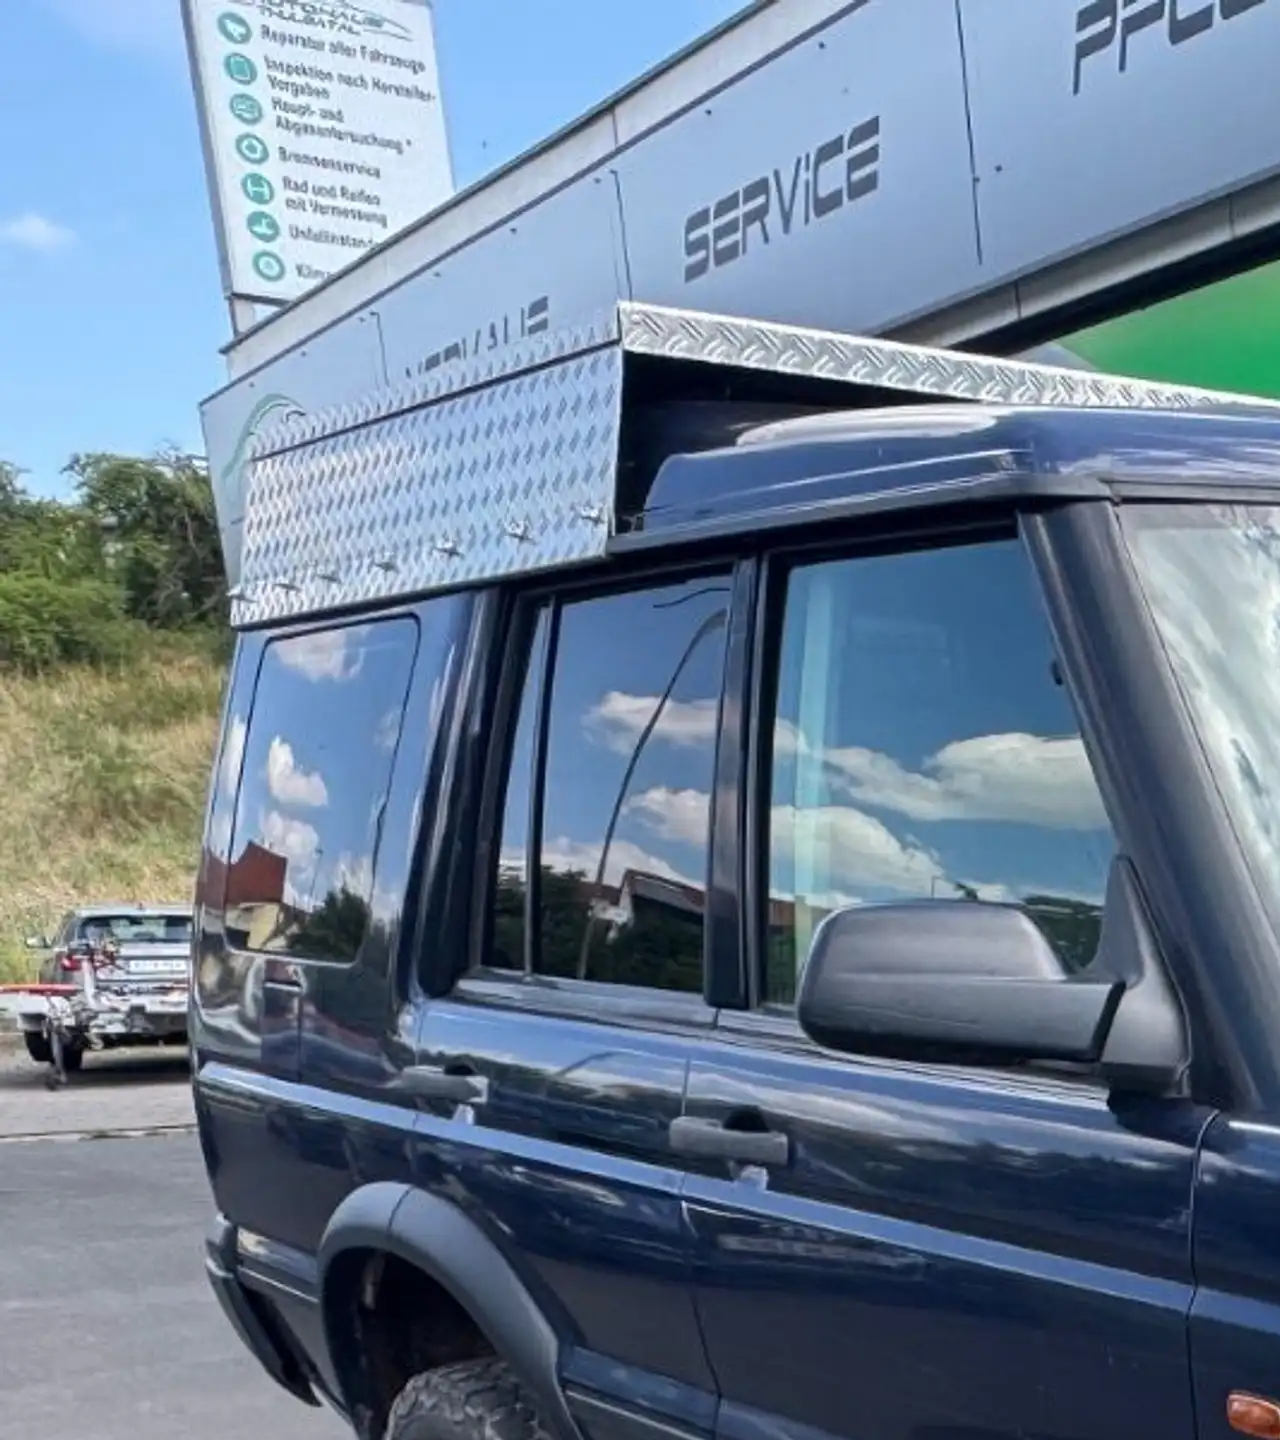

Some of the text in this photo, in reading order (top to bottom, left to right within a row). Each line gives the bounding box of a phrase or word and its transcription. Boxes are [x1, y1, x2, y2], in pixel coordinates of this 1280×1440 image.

[264, 54, 333, 83] Inspektion
[337, 73, 368, 90] nach
[360, 45, 426, 75] Fahrzeuge
[267, 74, 330, 99] Vorgaben
[278, 146, 381, 178] Bremsenservice
[282, 176, 381, 206] Rad und Reifen
[309, 198, 388, 229] Vermessung
